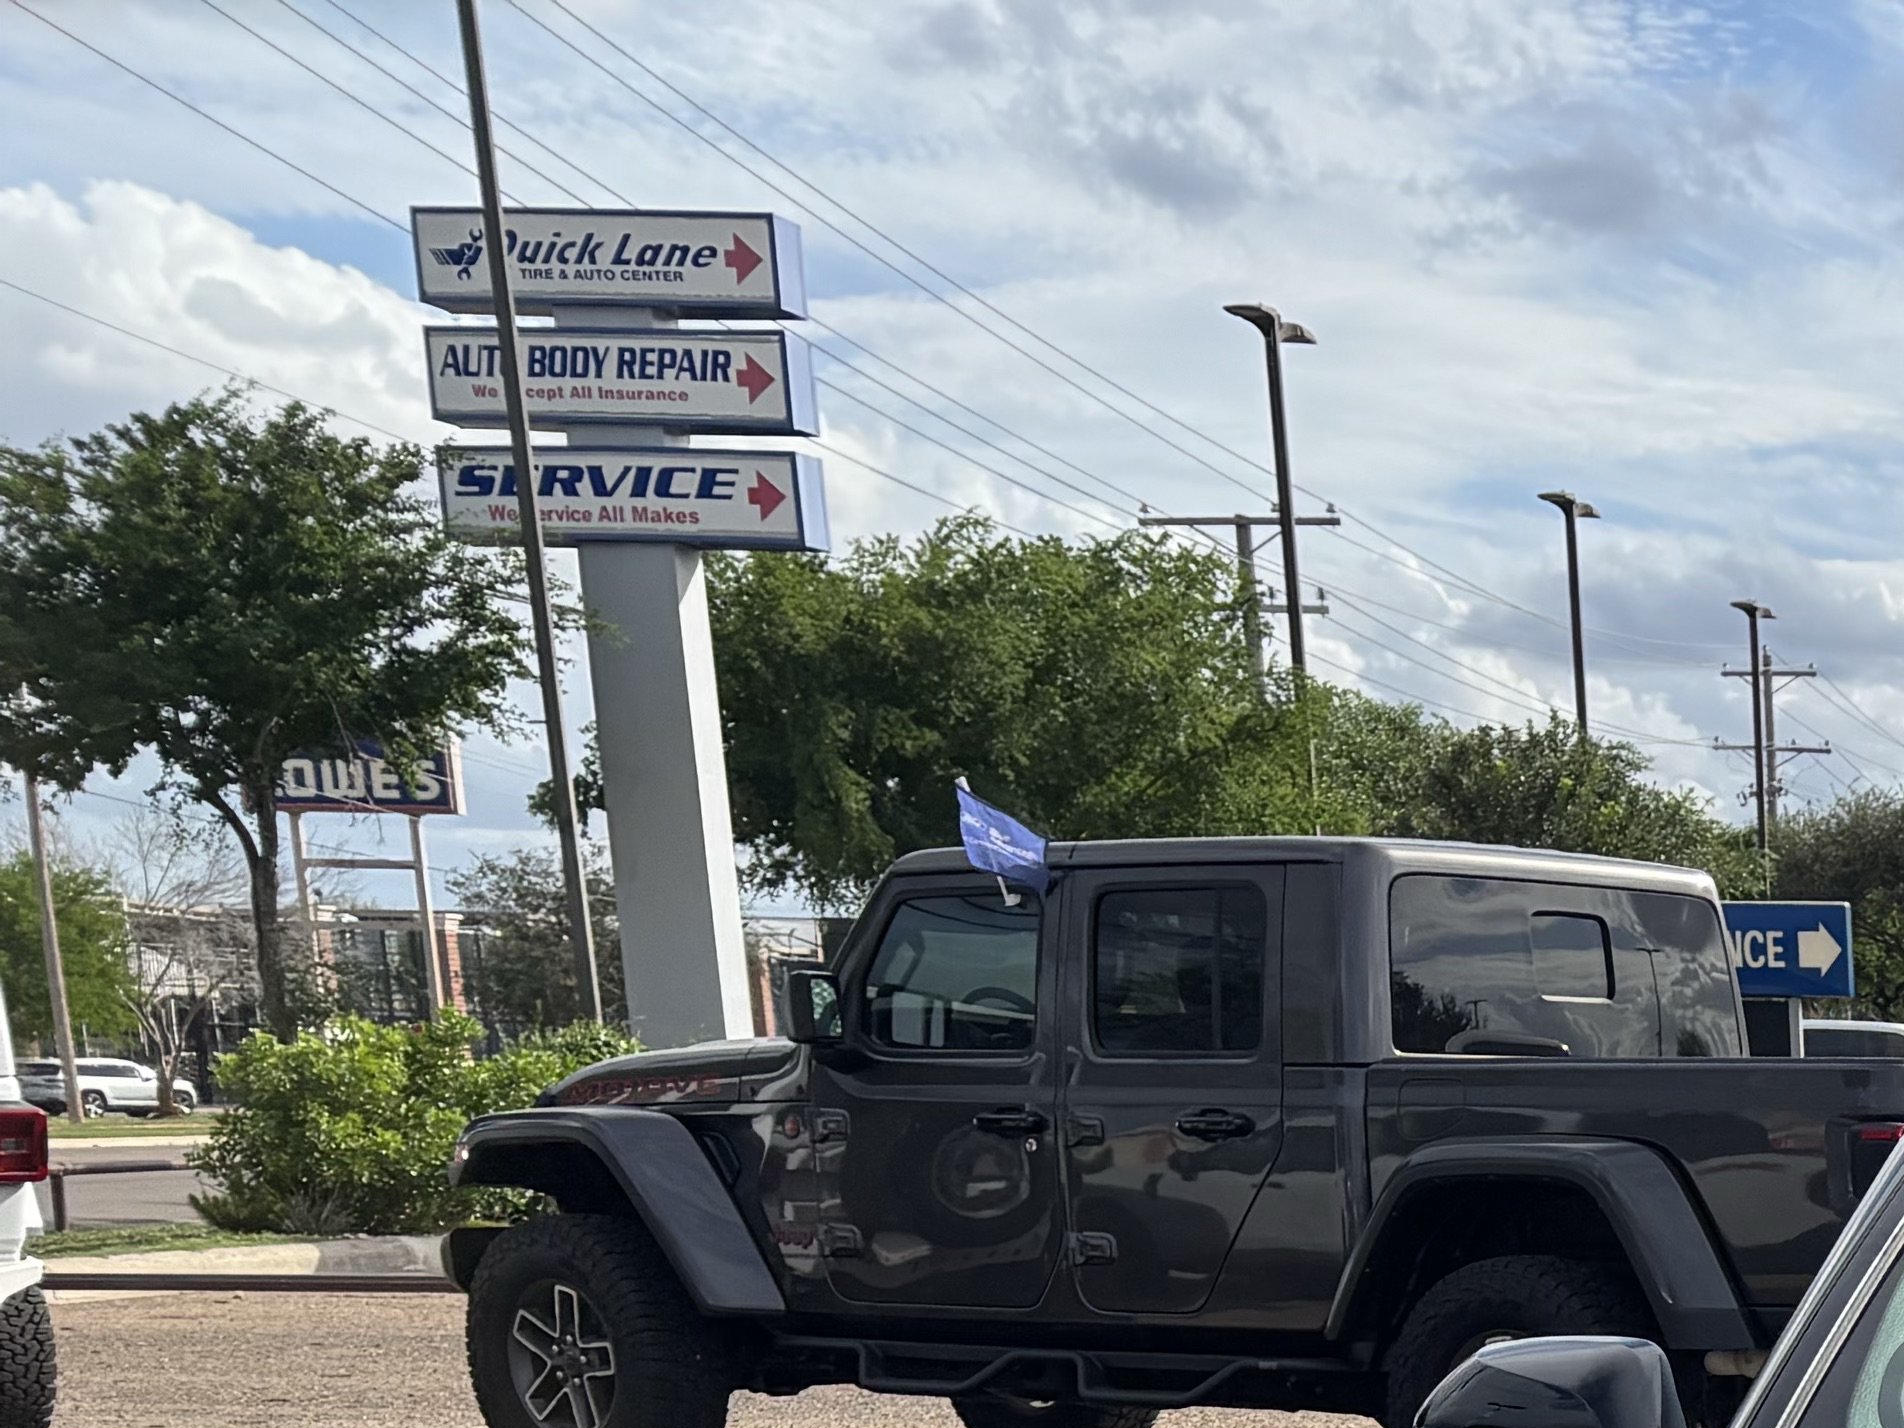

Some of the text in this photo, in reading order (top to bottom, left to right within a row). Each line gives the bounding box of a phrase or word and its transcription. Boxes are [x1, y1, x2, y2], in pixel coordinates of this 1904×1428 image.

[610, 232, 718, 268] Lane
[518, 268, 684, 282] TIRE & AUTO CENTER
[439, 344, 732, 383] AUT BODY REPAIR
[471, 384, 498, 398] We
[525, 385, 565, 402] cept
[569, 385, 592, 399] All
[487, 504, 700, 525] We ervice All Makes
